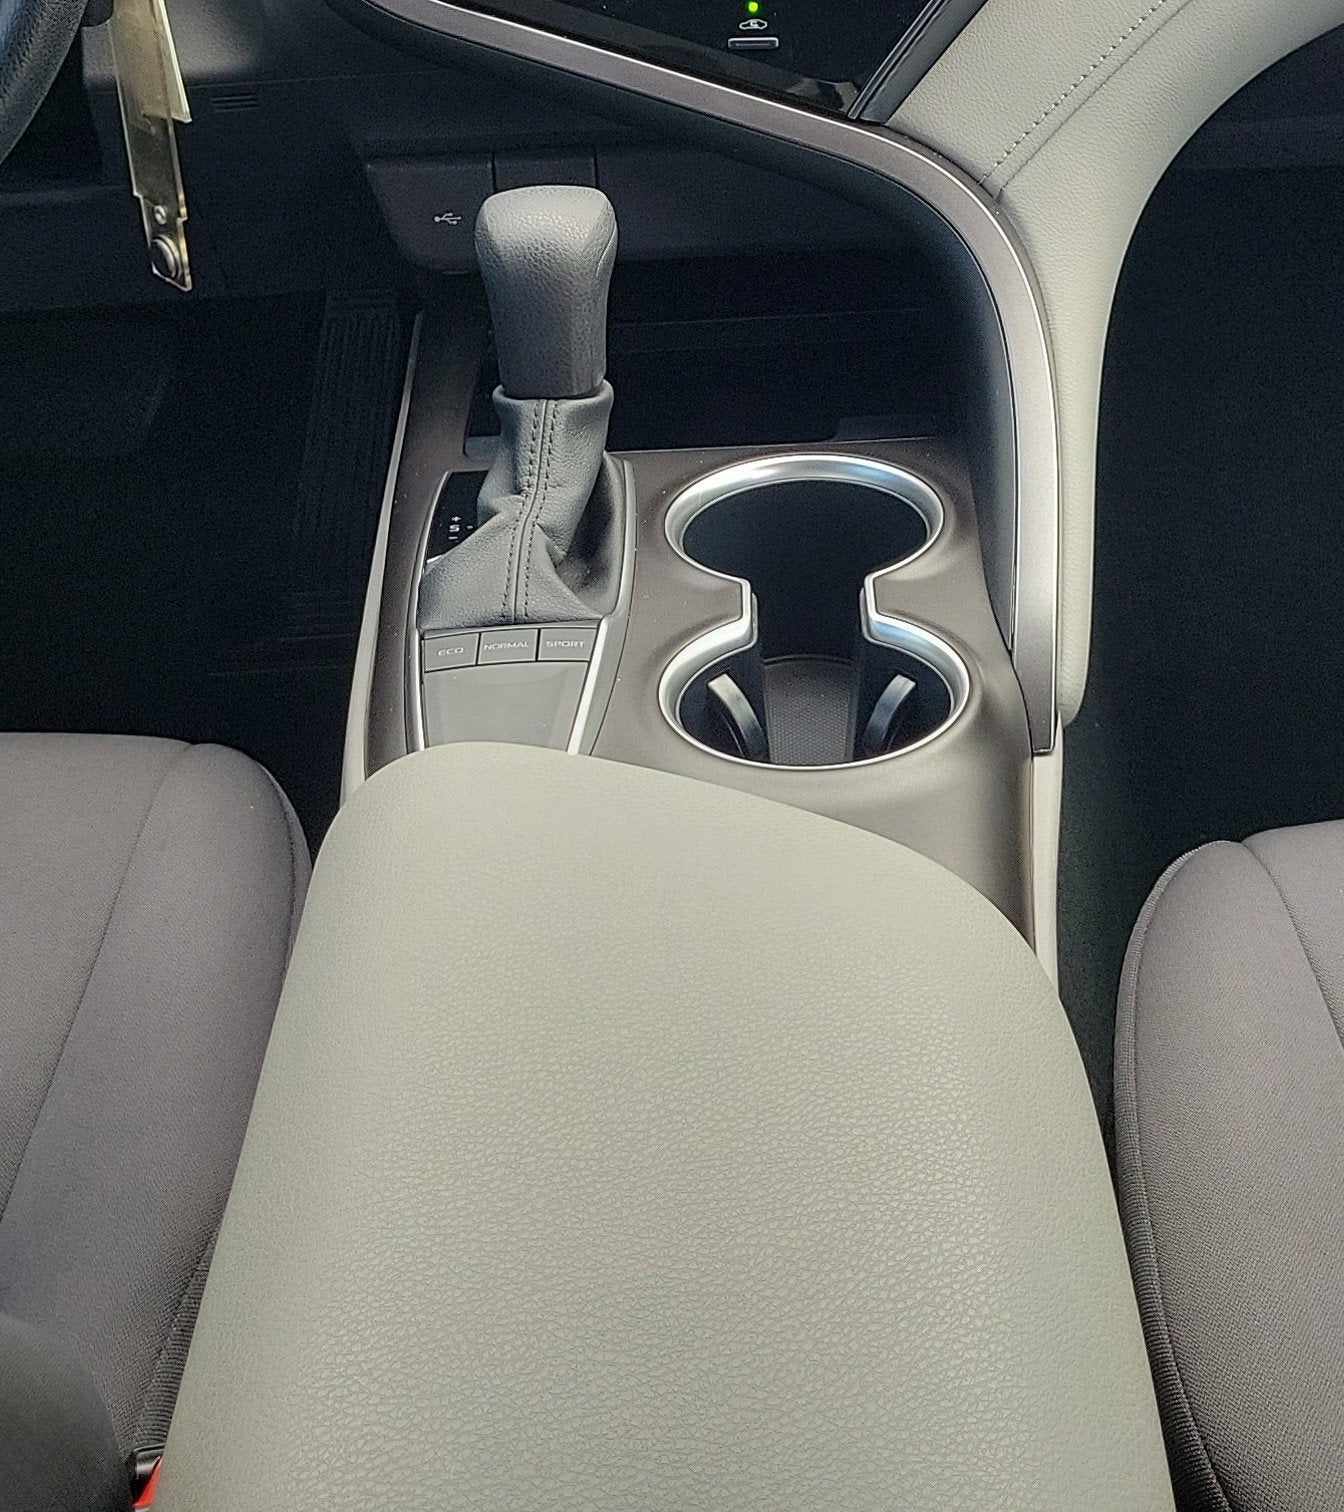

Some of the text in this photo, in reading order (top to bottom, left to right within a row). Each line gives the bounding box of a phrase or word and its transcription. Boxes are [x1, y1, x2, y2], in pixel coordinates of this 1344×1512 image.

[483, 641, 530, 651] NORMAL
[545, 639, 586, 649] SPORT
[438, 646, 464, 657] ECO
